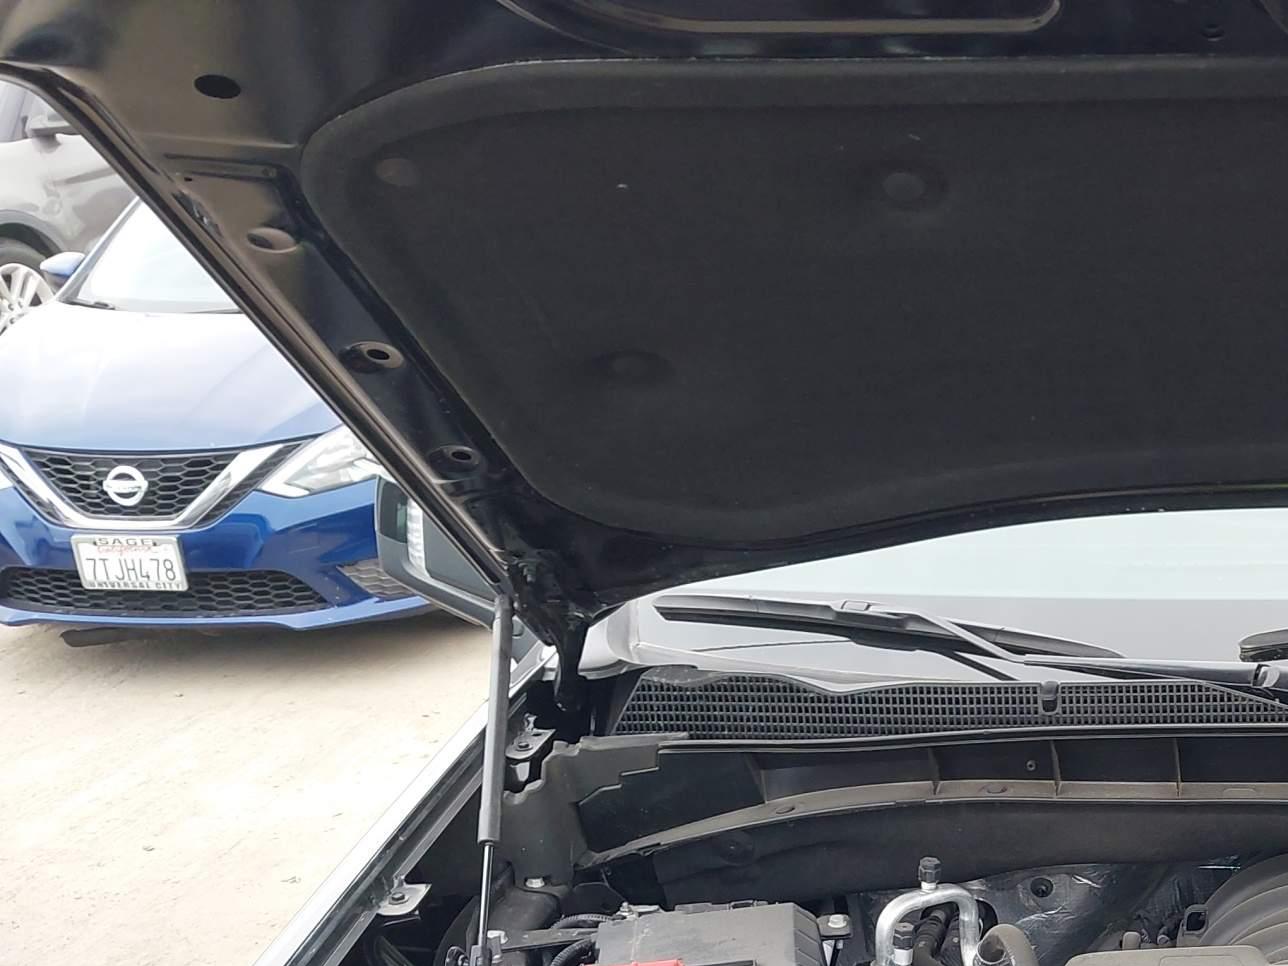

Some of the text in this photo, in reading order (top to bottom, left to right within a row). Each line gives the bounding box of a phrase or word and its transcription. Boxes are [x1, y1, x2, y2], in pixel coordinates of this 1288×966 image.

[98, 537, 152, 545] SAGE
[86, 558, 176, 581] 7TJH478
[156, 581, 181, 589] CITY
